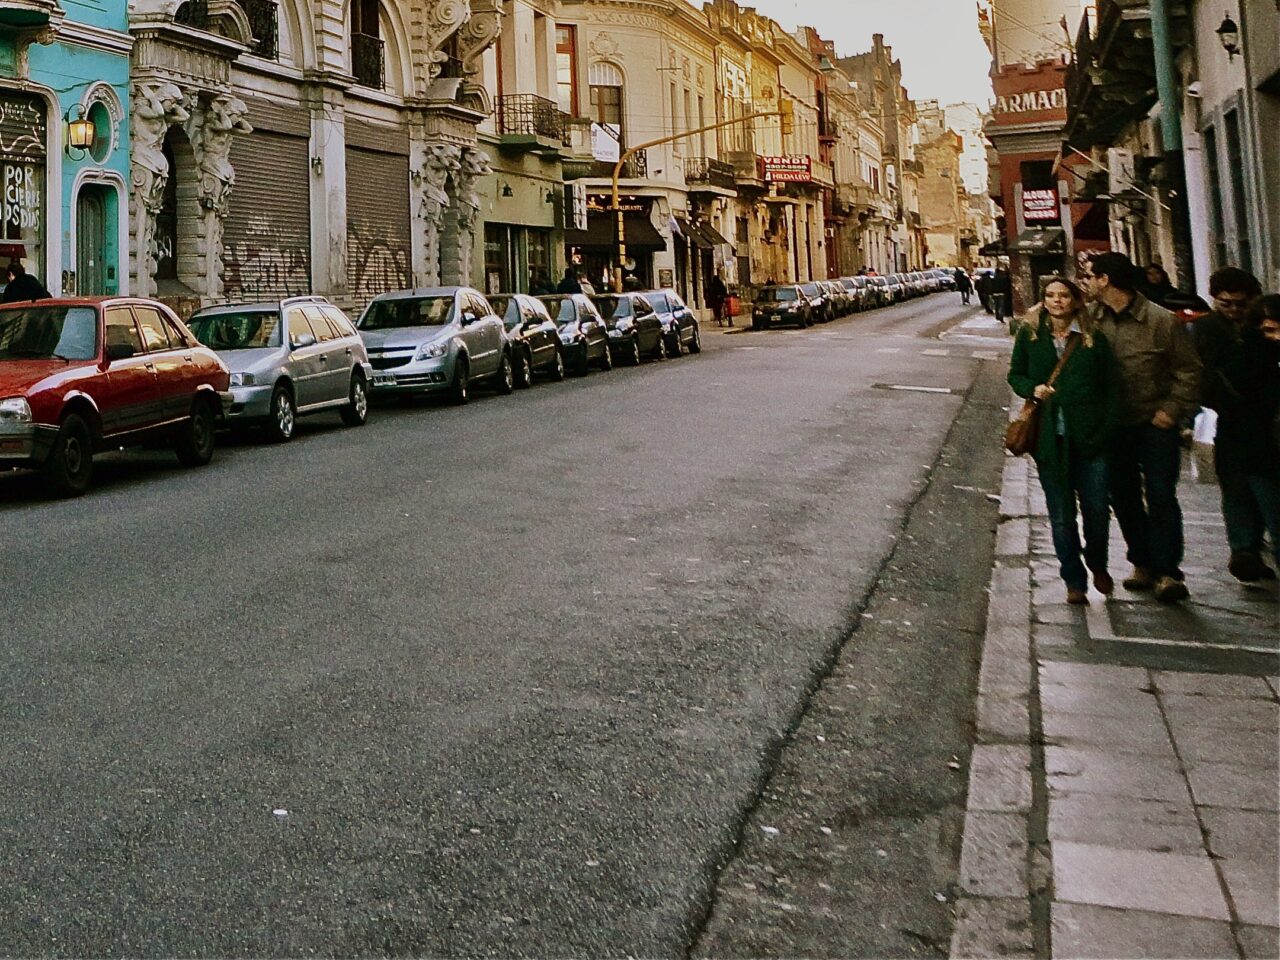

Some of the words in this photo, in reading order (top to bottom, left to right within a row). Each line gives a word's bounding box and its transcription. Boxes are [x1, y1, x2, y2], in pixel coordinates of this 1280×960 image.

[998, 88, 1067, 114] ARMACI
[763, 157, 809, 165] VENDE
[6, 165, 34, 191] POR
